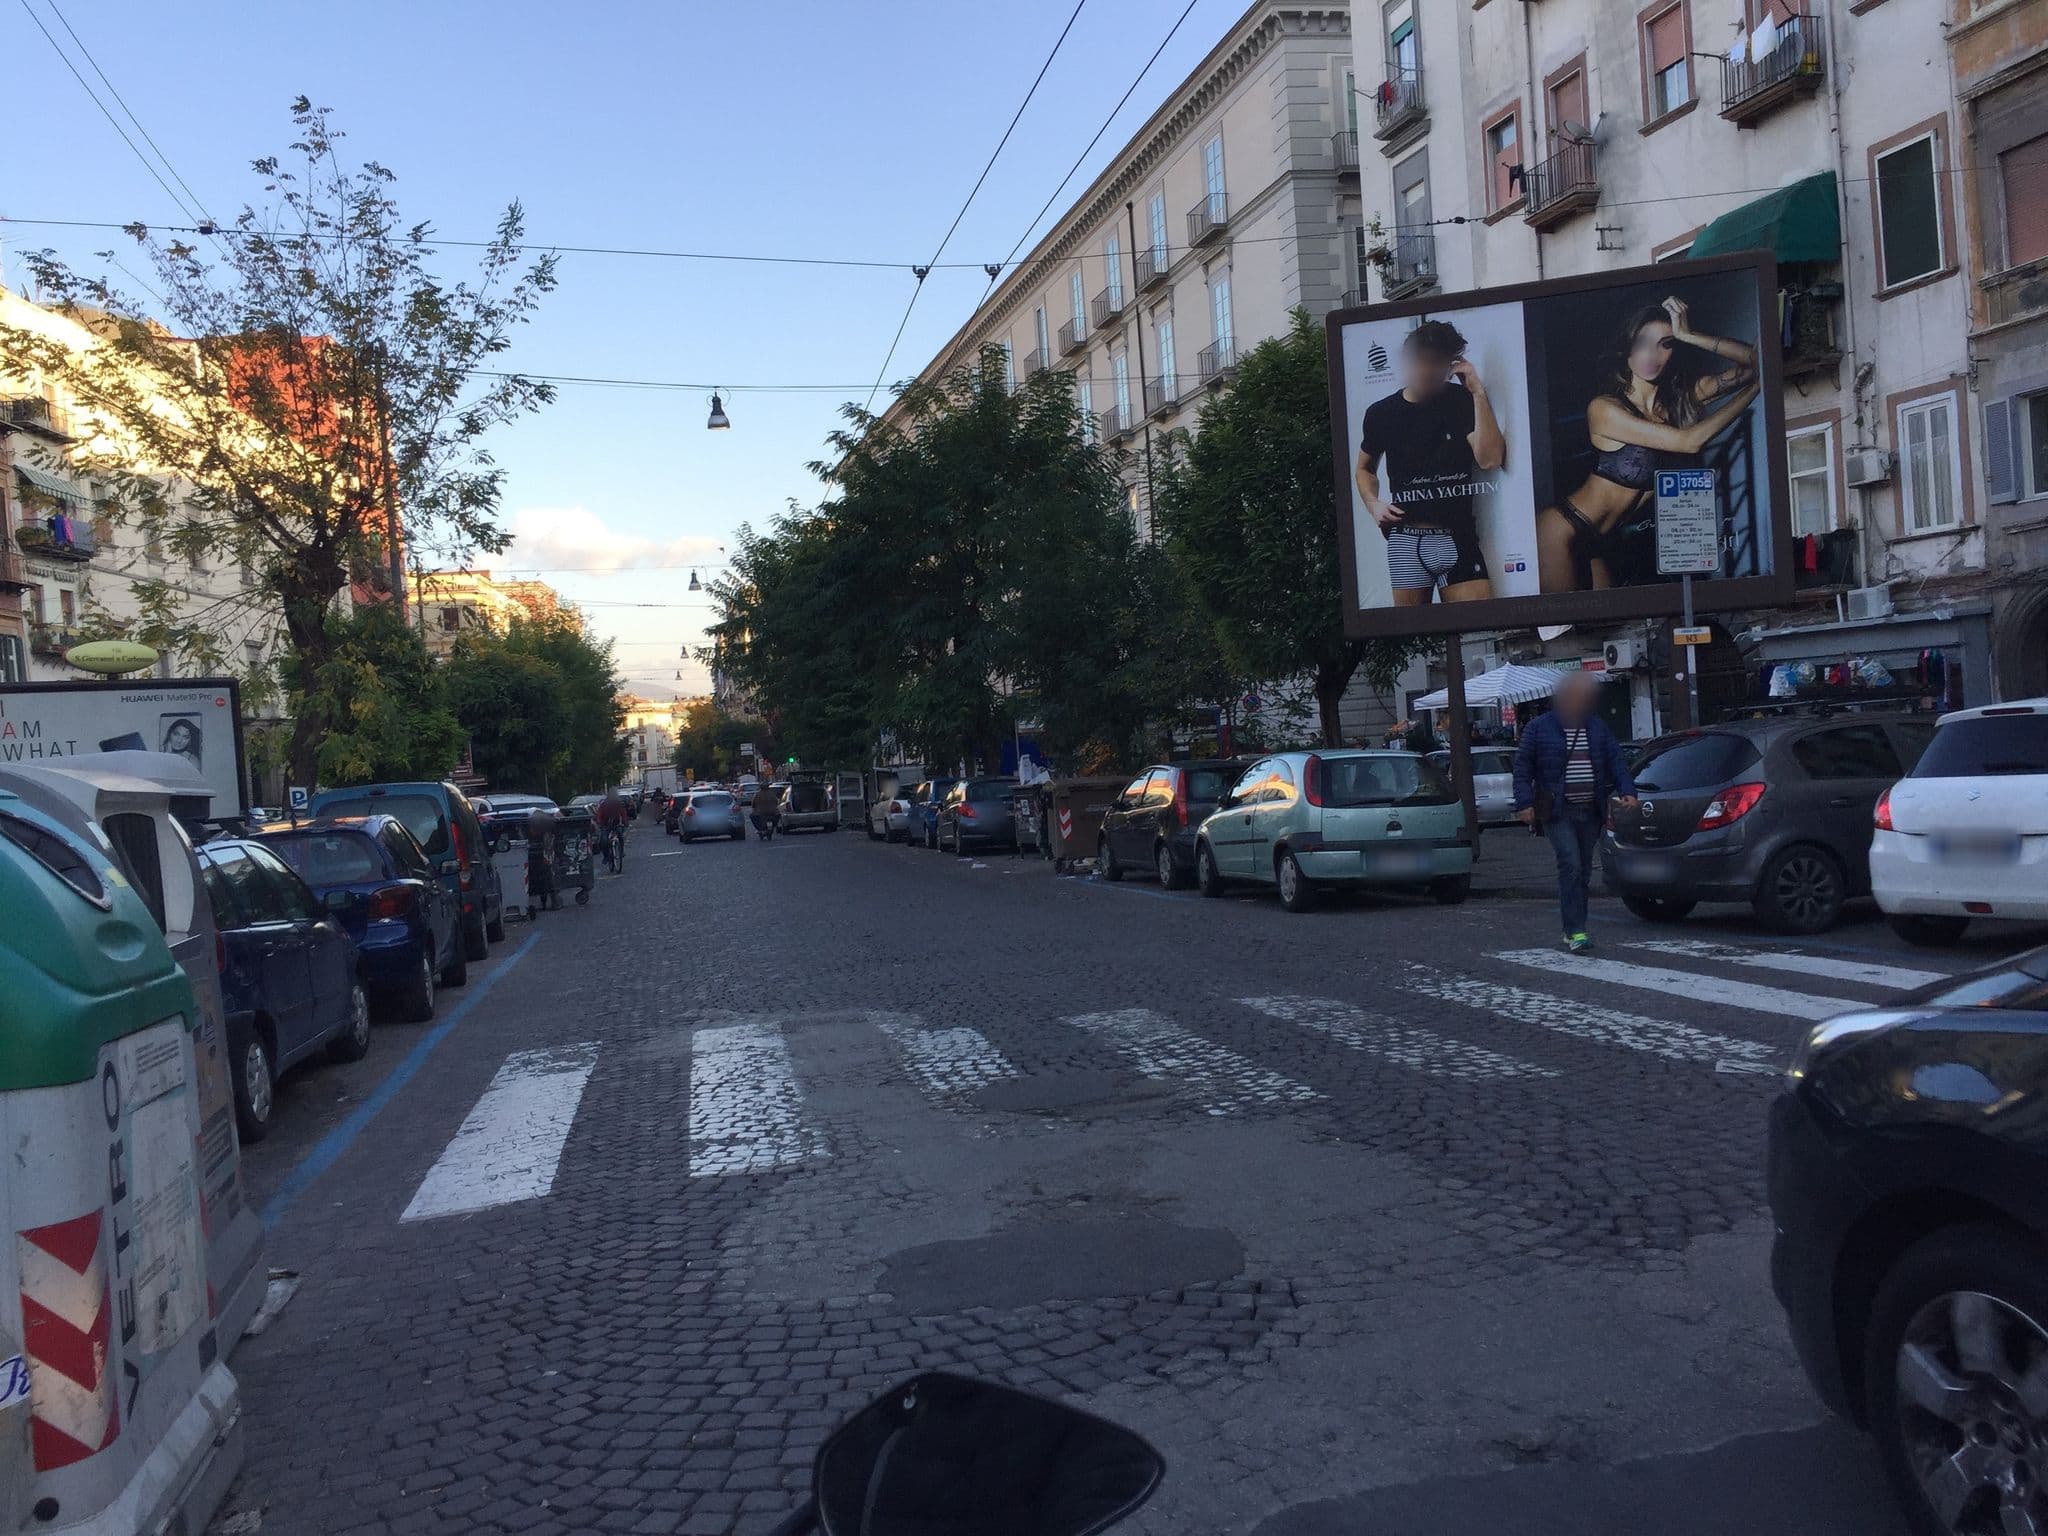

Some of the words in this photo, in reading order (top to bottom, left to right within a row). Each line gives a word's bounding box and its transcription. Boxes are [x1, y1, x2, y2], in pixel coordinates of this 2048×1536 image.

[1663, 476, 1675, 495] P
[121, 695, 164, 703] HUAWEI
[2, 720, 41, 740] AM
[2, 740, 78, 761] WHAT
